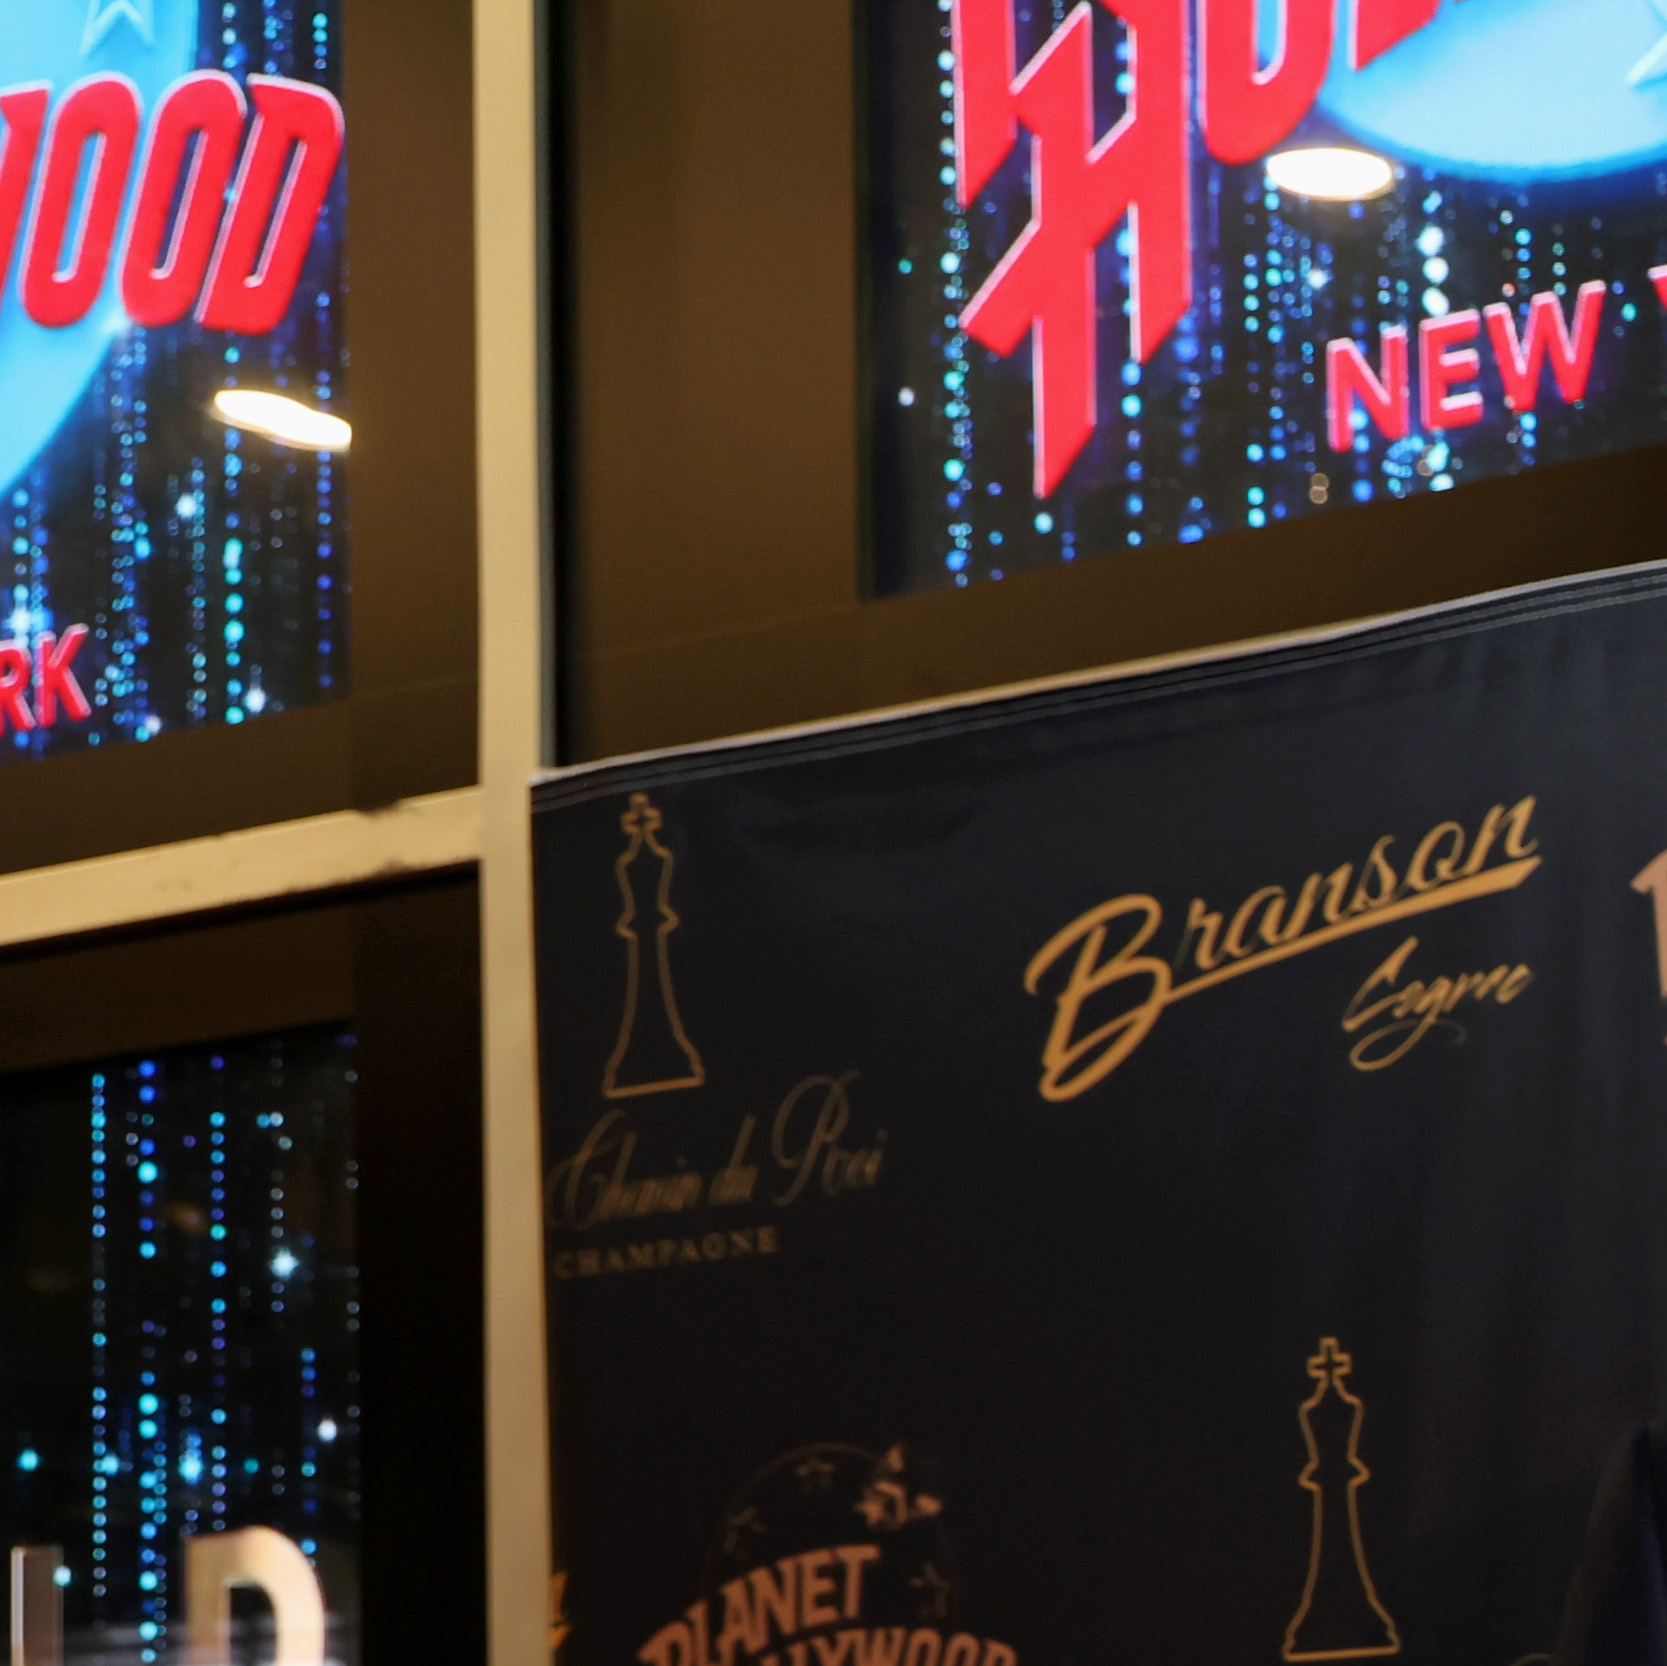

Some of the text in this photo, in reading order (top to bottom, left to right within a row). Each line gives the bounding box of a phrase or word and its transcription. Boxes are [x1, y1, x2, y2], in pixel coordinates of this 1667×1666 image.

[0, 68, 345, 335] OOD
[1327, 280, 1606, 453] NEW
[1024, 795, 1543, 1102] Branson
